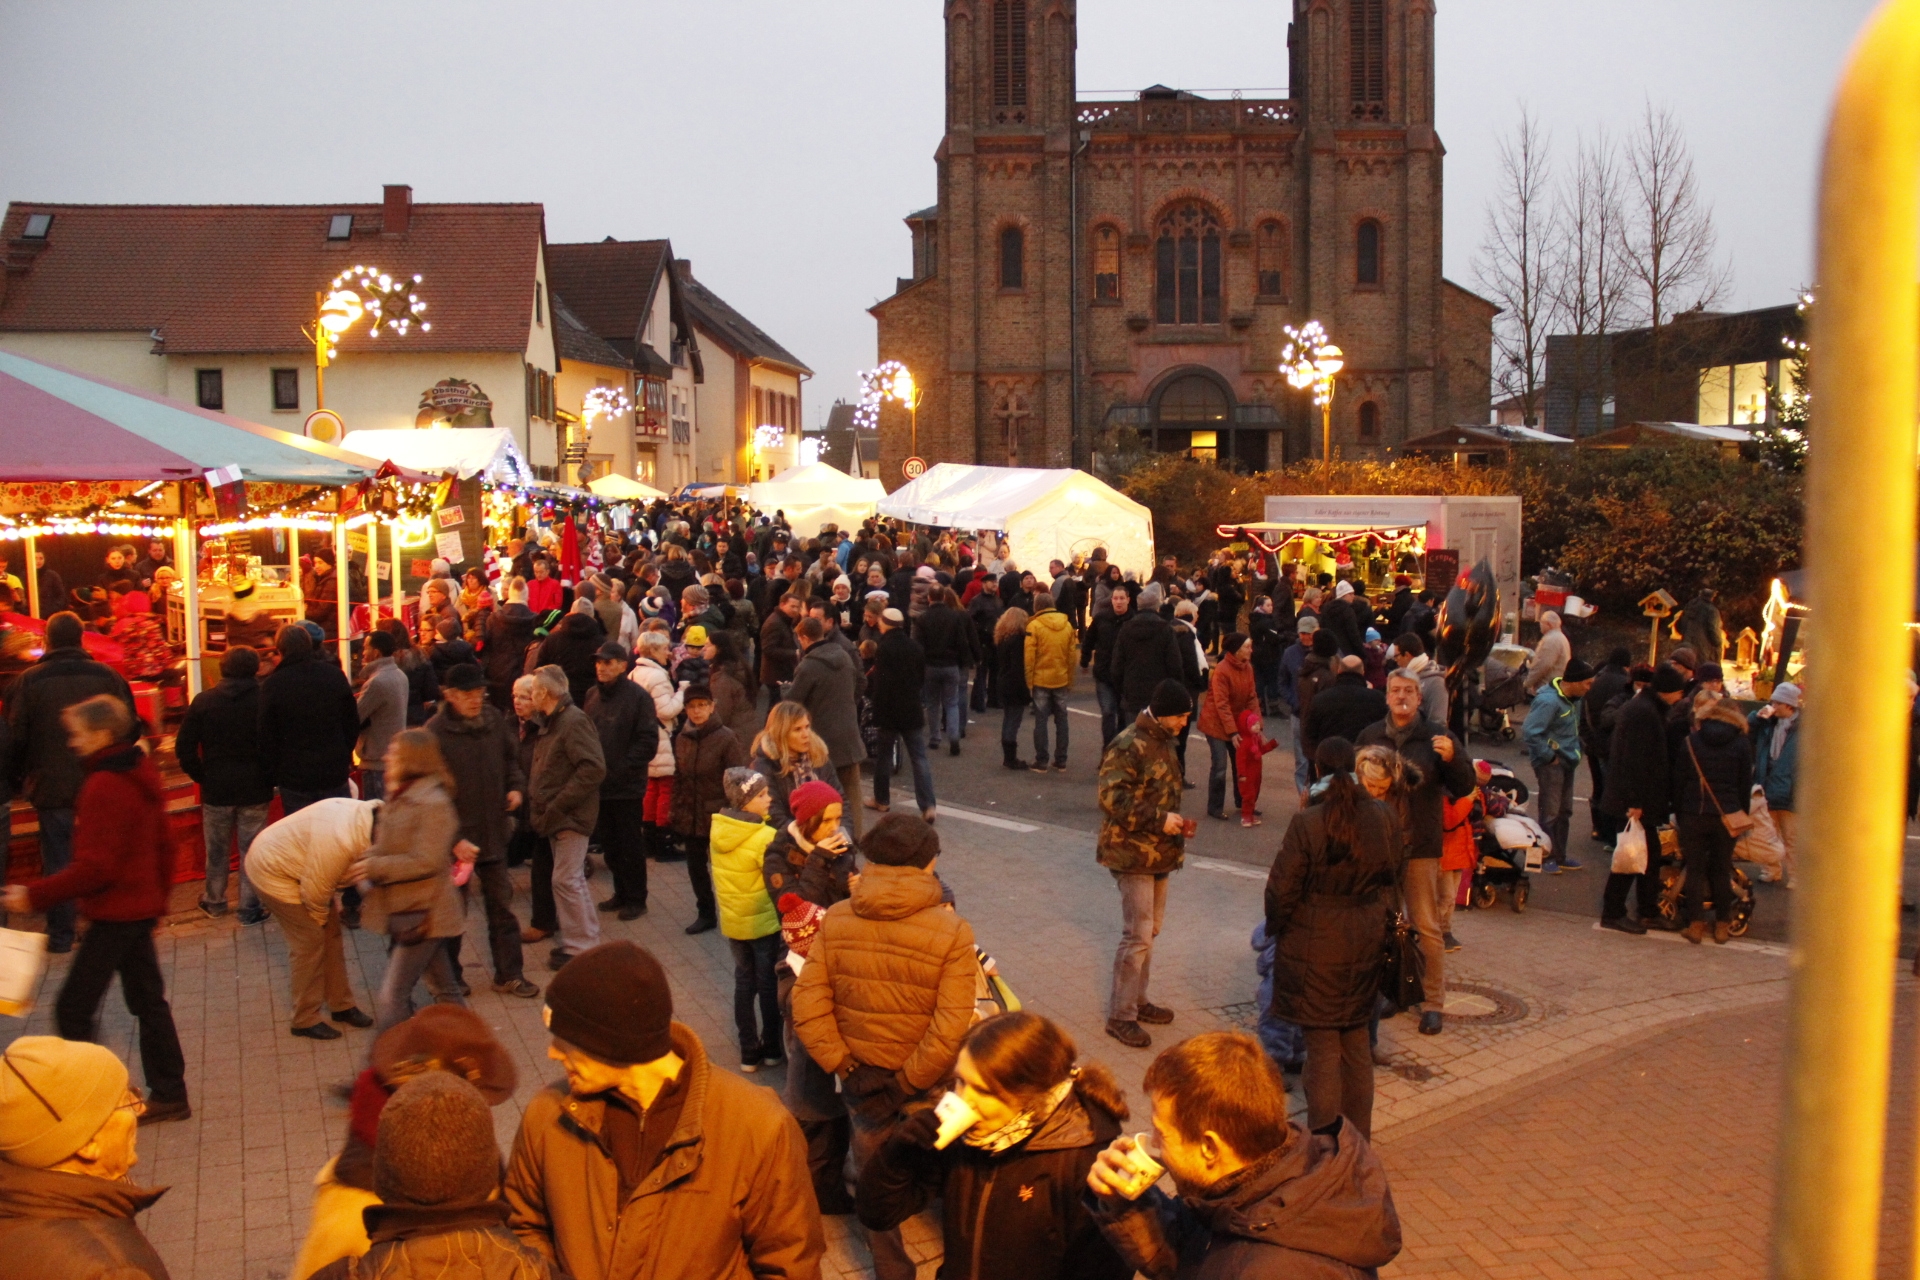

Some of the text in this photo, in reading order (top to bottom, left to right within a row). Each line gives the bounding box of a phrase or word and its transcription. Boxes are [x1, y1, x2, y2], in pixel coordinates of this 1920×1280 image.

[433, 387, 469, 395] Obsthof
[463, 398, 491, 407] Kirche
[908, 463, 922, 475] 30
